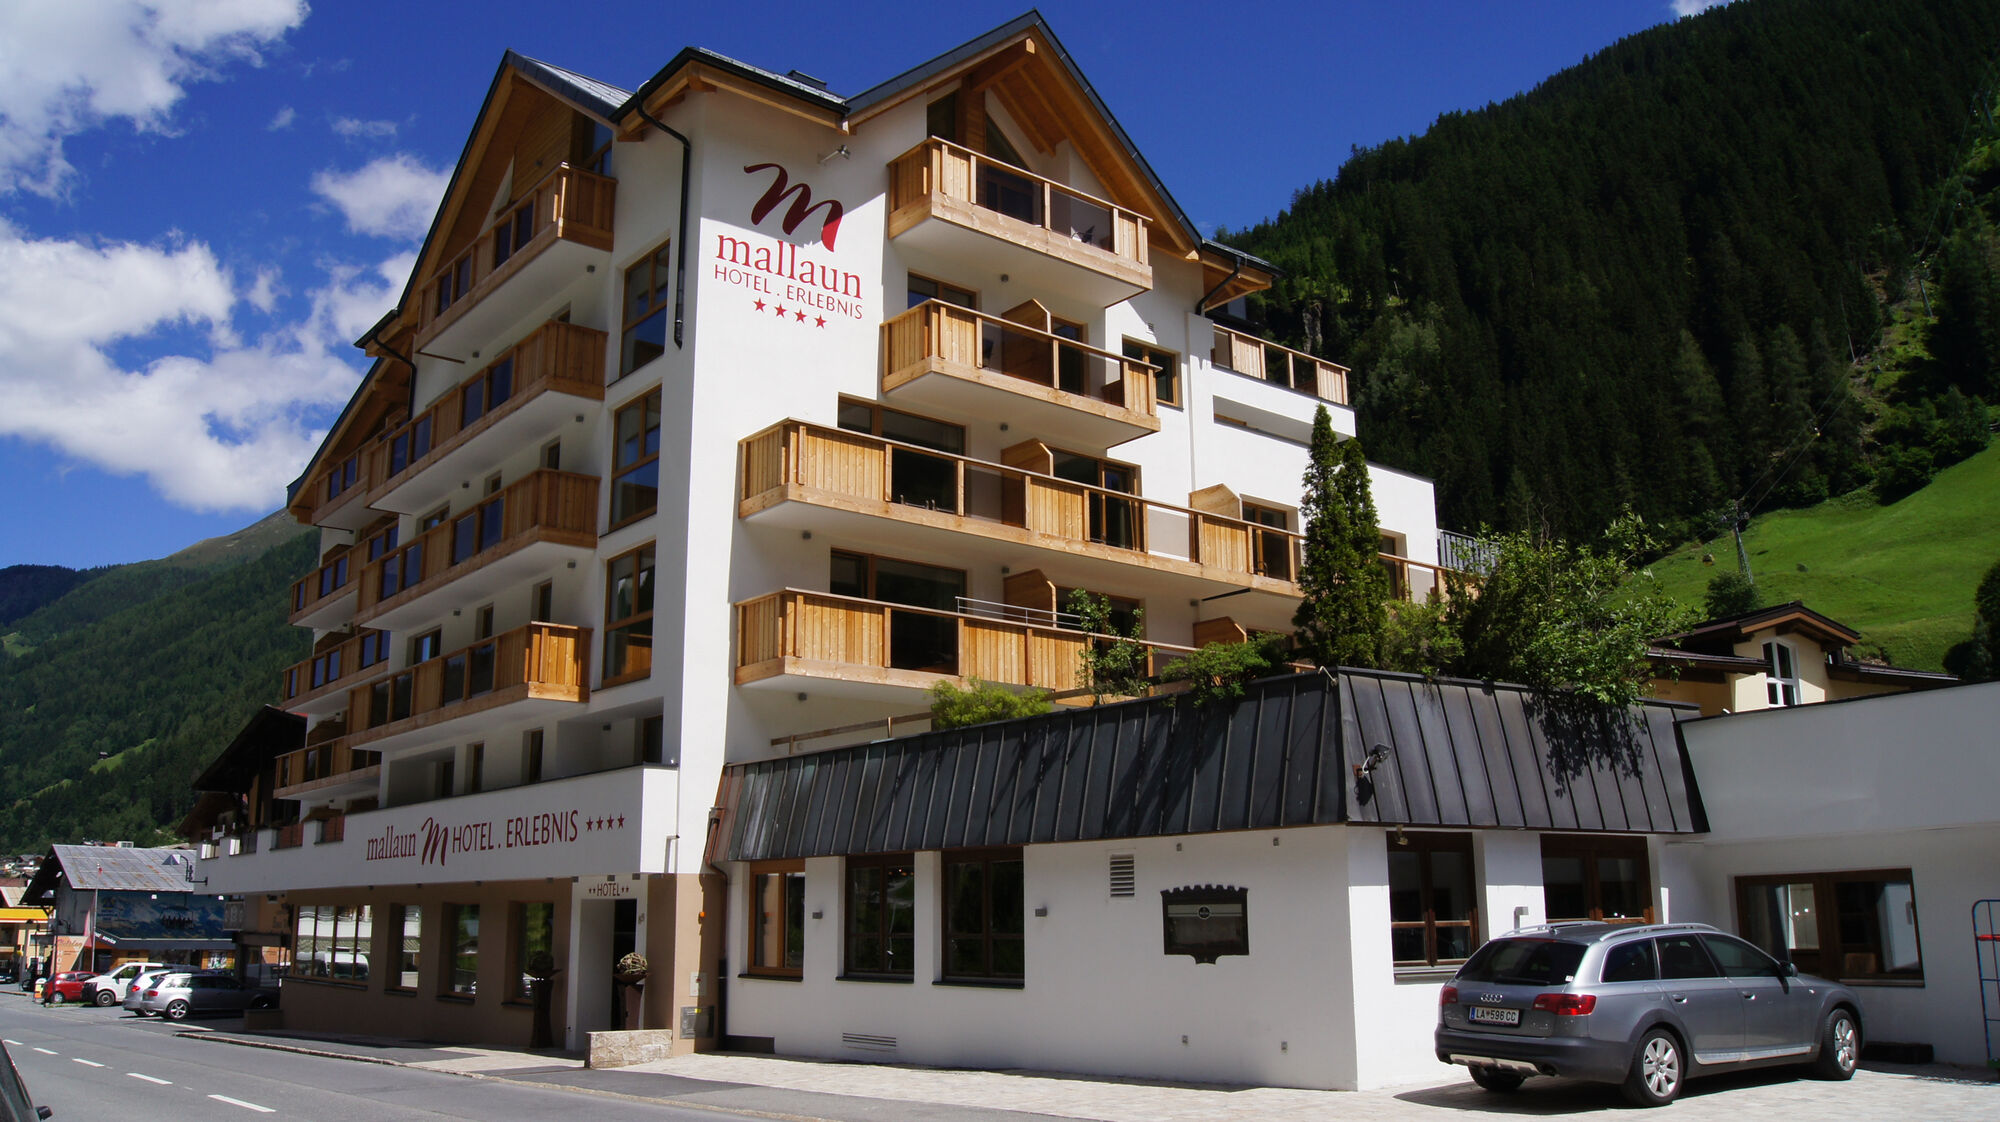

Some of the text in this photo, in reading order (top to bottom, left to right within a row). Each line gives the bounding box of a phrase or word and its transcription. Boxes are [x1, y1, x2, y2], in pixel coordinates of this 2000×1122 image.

[716, 234, 864, 300] mallaun
[786, 284, 864, 320] ERLEBNIS
[366, 826, 416, 861] mallaun
[506, 809, 579, 849] ERLEBNIS
[596, 882, 621, 897] HOTEL
[1476, 1008, 1487, 1020] LA
